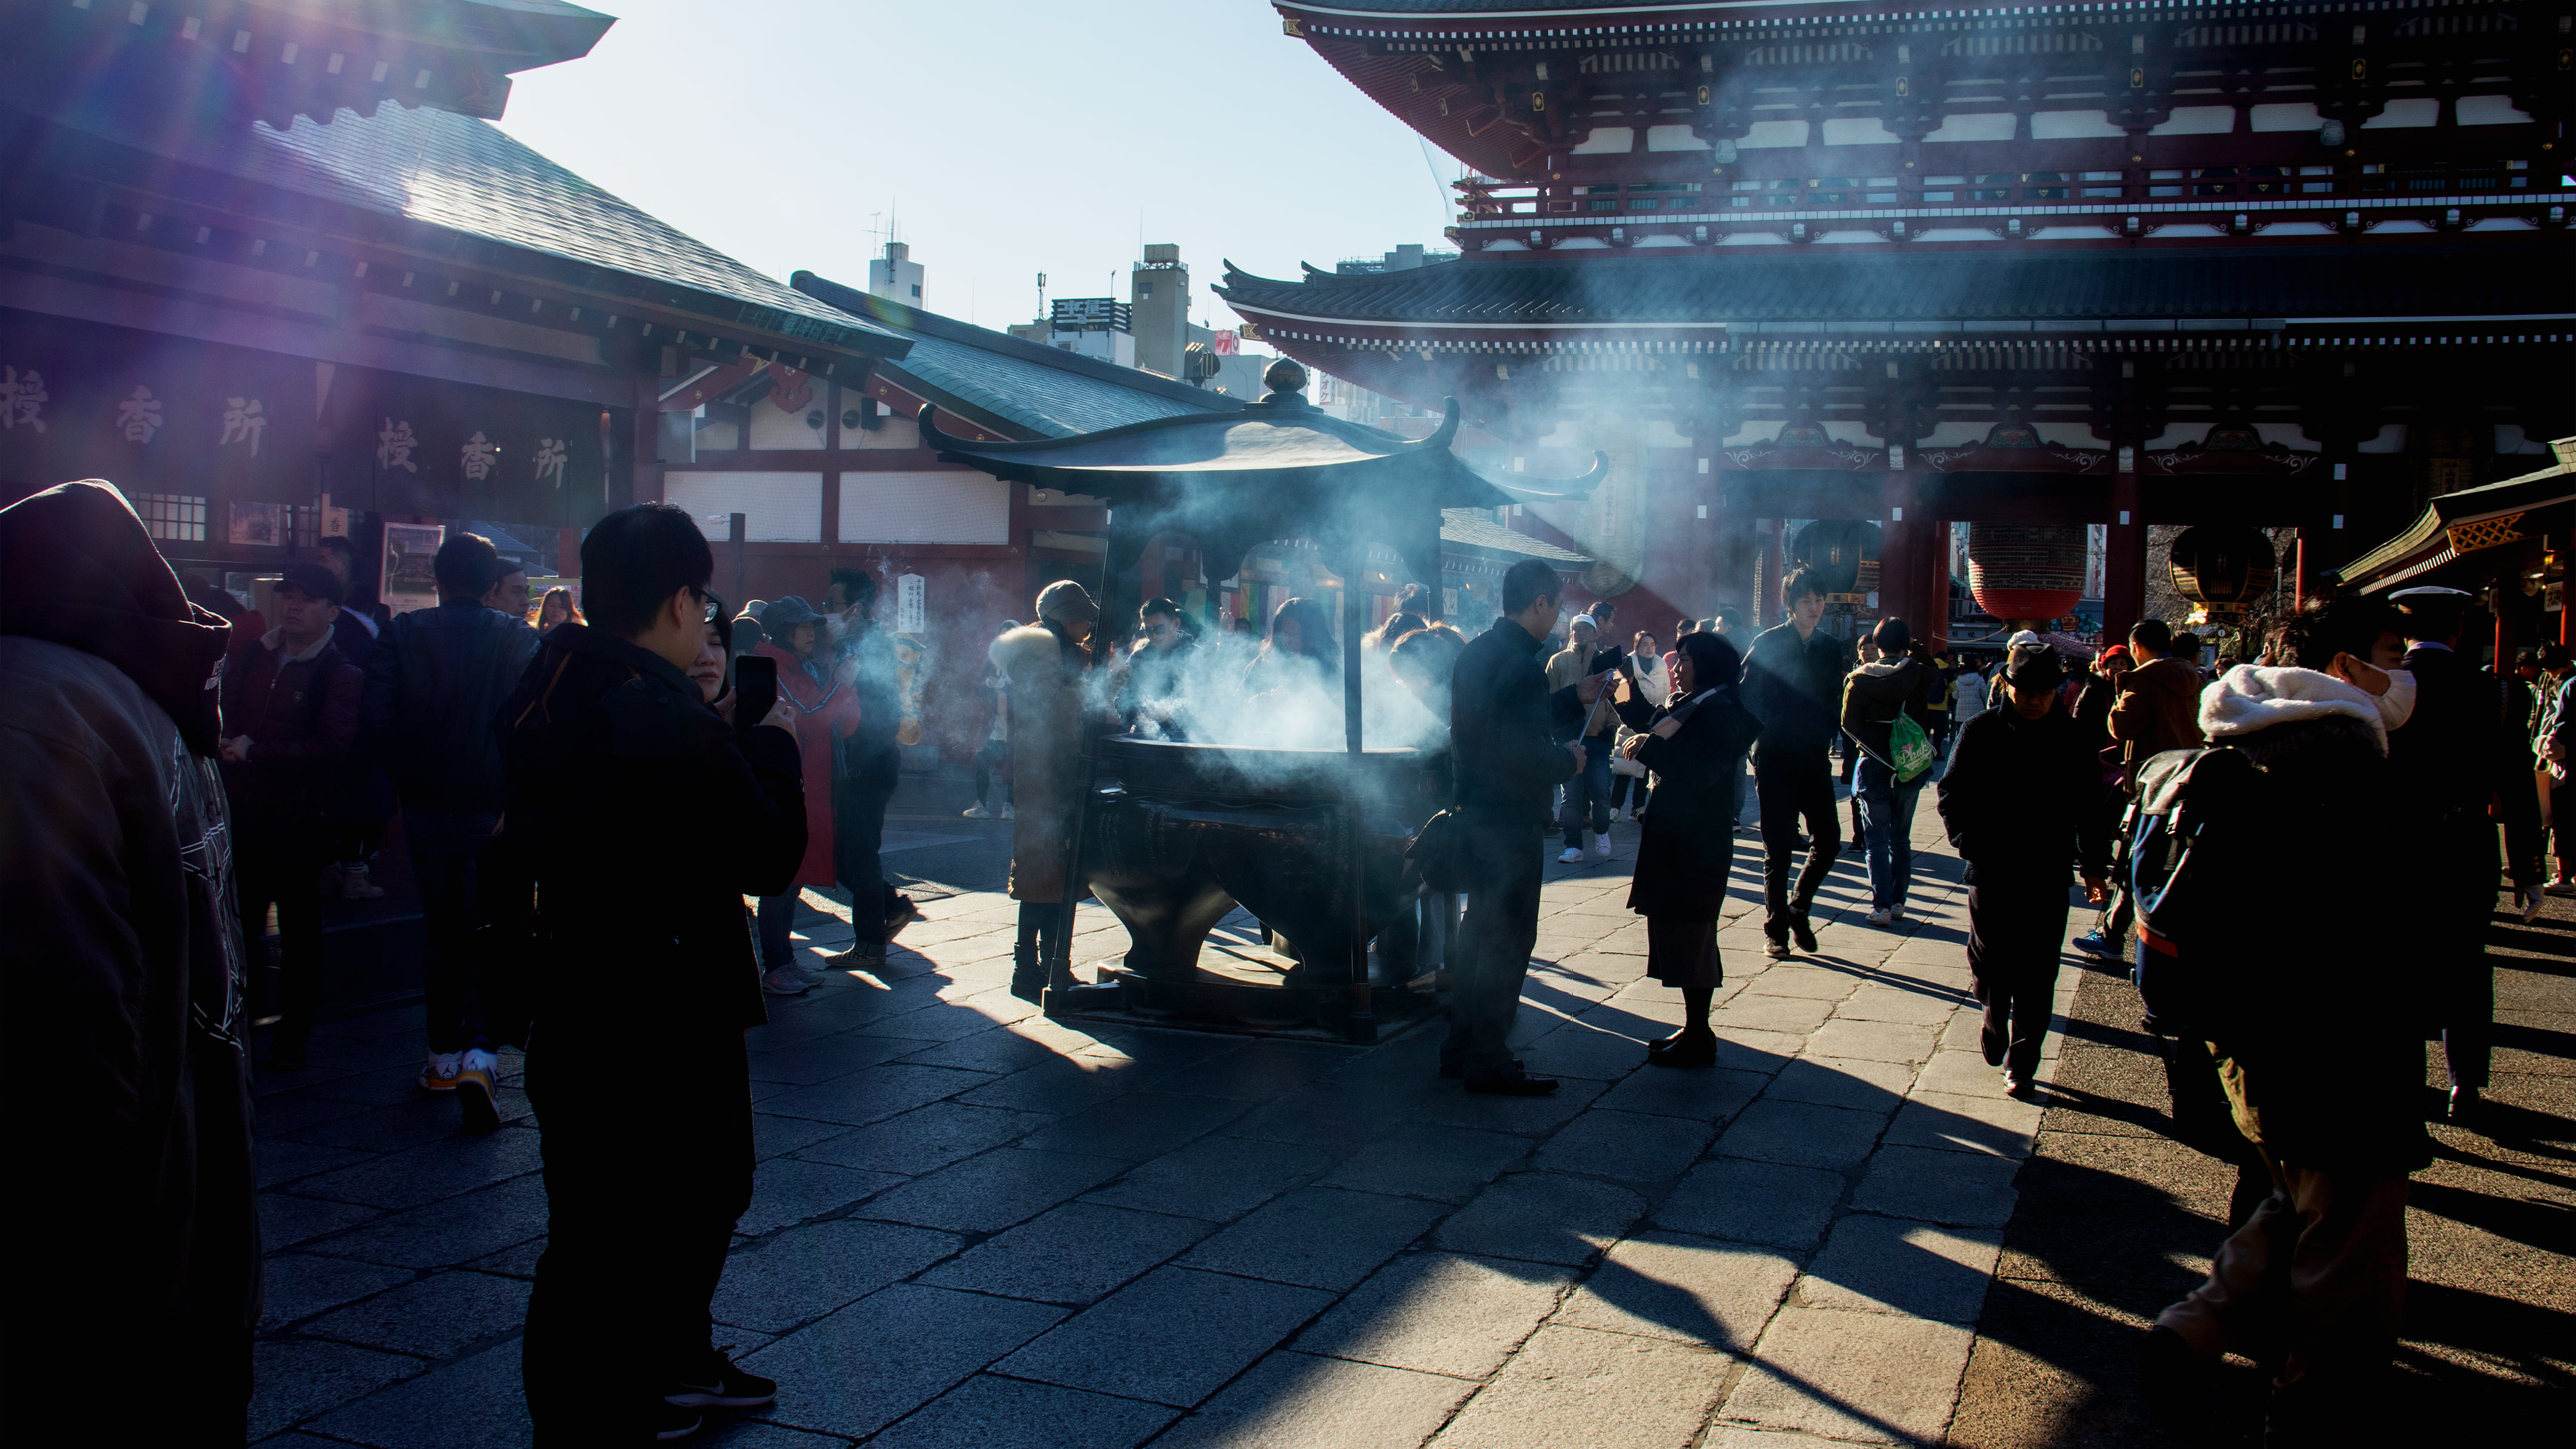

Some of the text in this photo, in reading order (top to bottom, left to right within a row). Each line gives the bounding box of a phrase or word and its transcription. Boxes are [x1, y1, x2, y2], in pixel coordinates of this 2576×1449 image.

[0, 364, 268, 458] 授香所
[377, 416, 569, 490] 授香所
